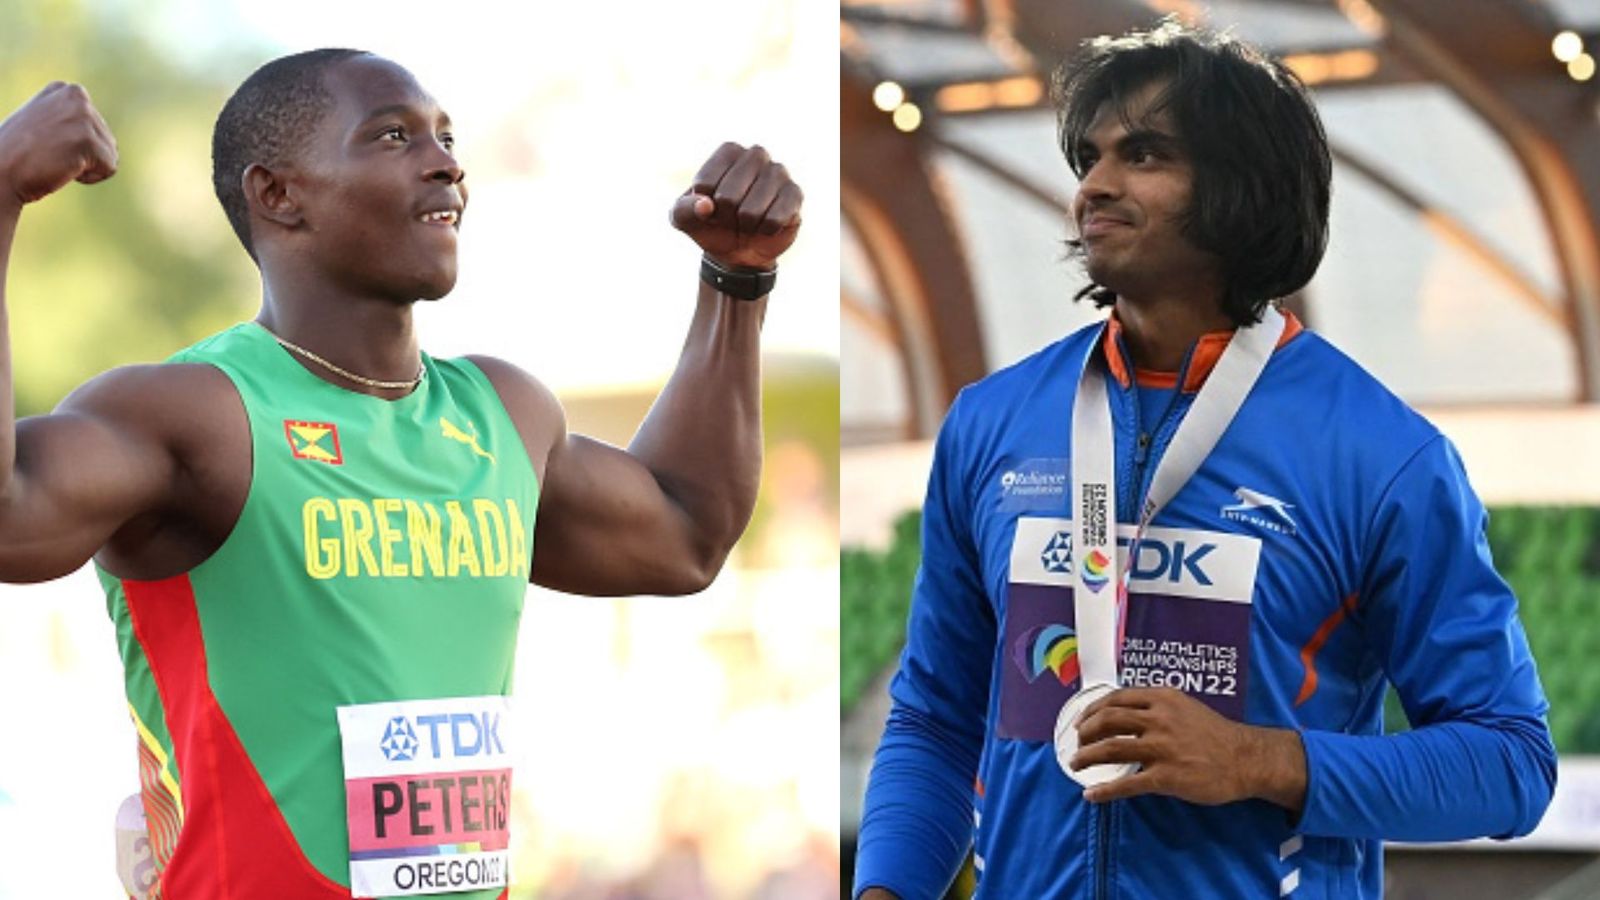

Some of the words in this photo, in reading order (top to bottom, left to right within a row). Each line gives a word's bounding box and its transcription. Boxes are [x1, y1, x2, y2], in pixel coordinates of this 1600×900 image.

[302, 496, 529, 579] GRENADA
[1123, 652, 1237, 674] AMPIONSHIPS
[1125, 638, 1156, 651] ORLD
[1158, 641, 1237, 659] ATHLETICS
[416, 711, 505, 759] TDK
[372, 774, 507, 838] PETERS
